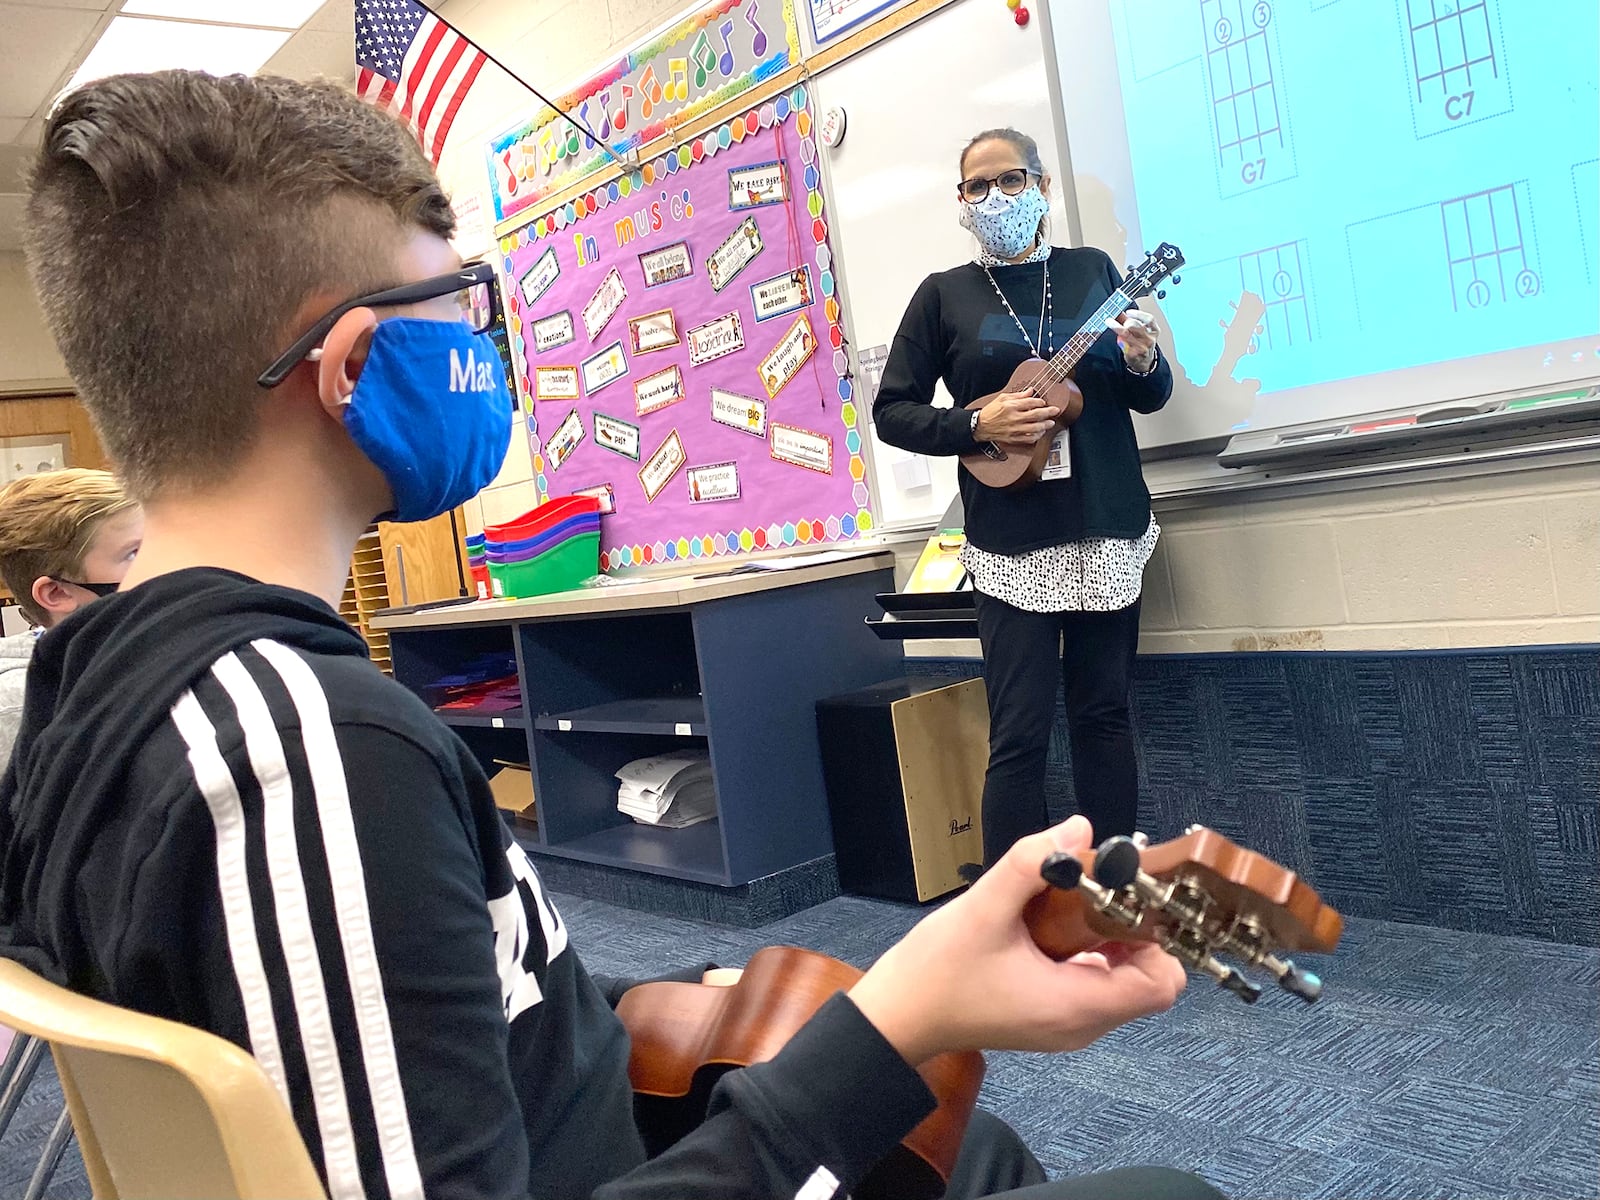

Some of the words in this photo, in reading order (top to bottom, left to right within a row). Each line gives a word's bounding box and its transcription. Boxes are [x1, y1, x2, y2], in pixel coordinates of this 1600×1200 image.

[1257, 5, 1267, 24] 3
[1218, 22, 1229, 40] 2
[1444, 90, 1475, 121] C7
[1241, 158, 1267, 185] G7
[573, 233, 599, 267] In
[645, 261, 656, 271] We
[656, 257, 665, 267] all
[759, 290, 768, 299] We
[1522, 274, 1535, 294] 2
[762, 300, 776, 310] each
[766, 359, 779, 373] We
[775, 341, 795, 365] laugh
[793, 328, 803, 344] and
[782, 354, 799, 377] play
[639, 392, 648, 401] We
[648, 387, 662, 398] work
[661, 380, 674, 392] hard
[715, 401, 726, 411] We
[726, 404, 747, 417] dream
[747, 408, 761, 422] BIG
[699, 474, 708, 483] We
[708, 472, 730, 483] practice
[949, 816, 973, 837] Pearl
